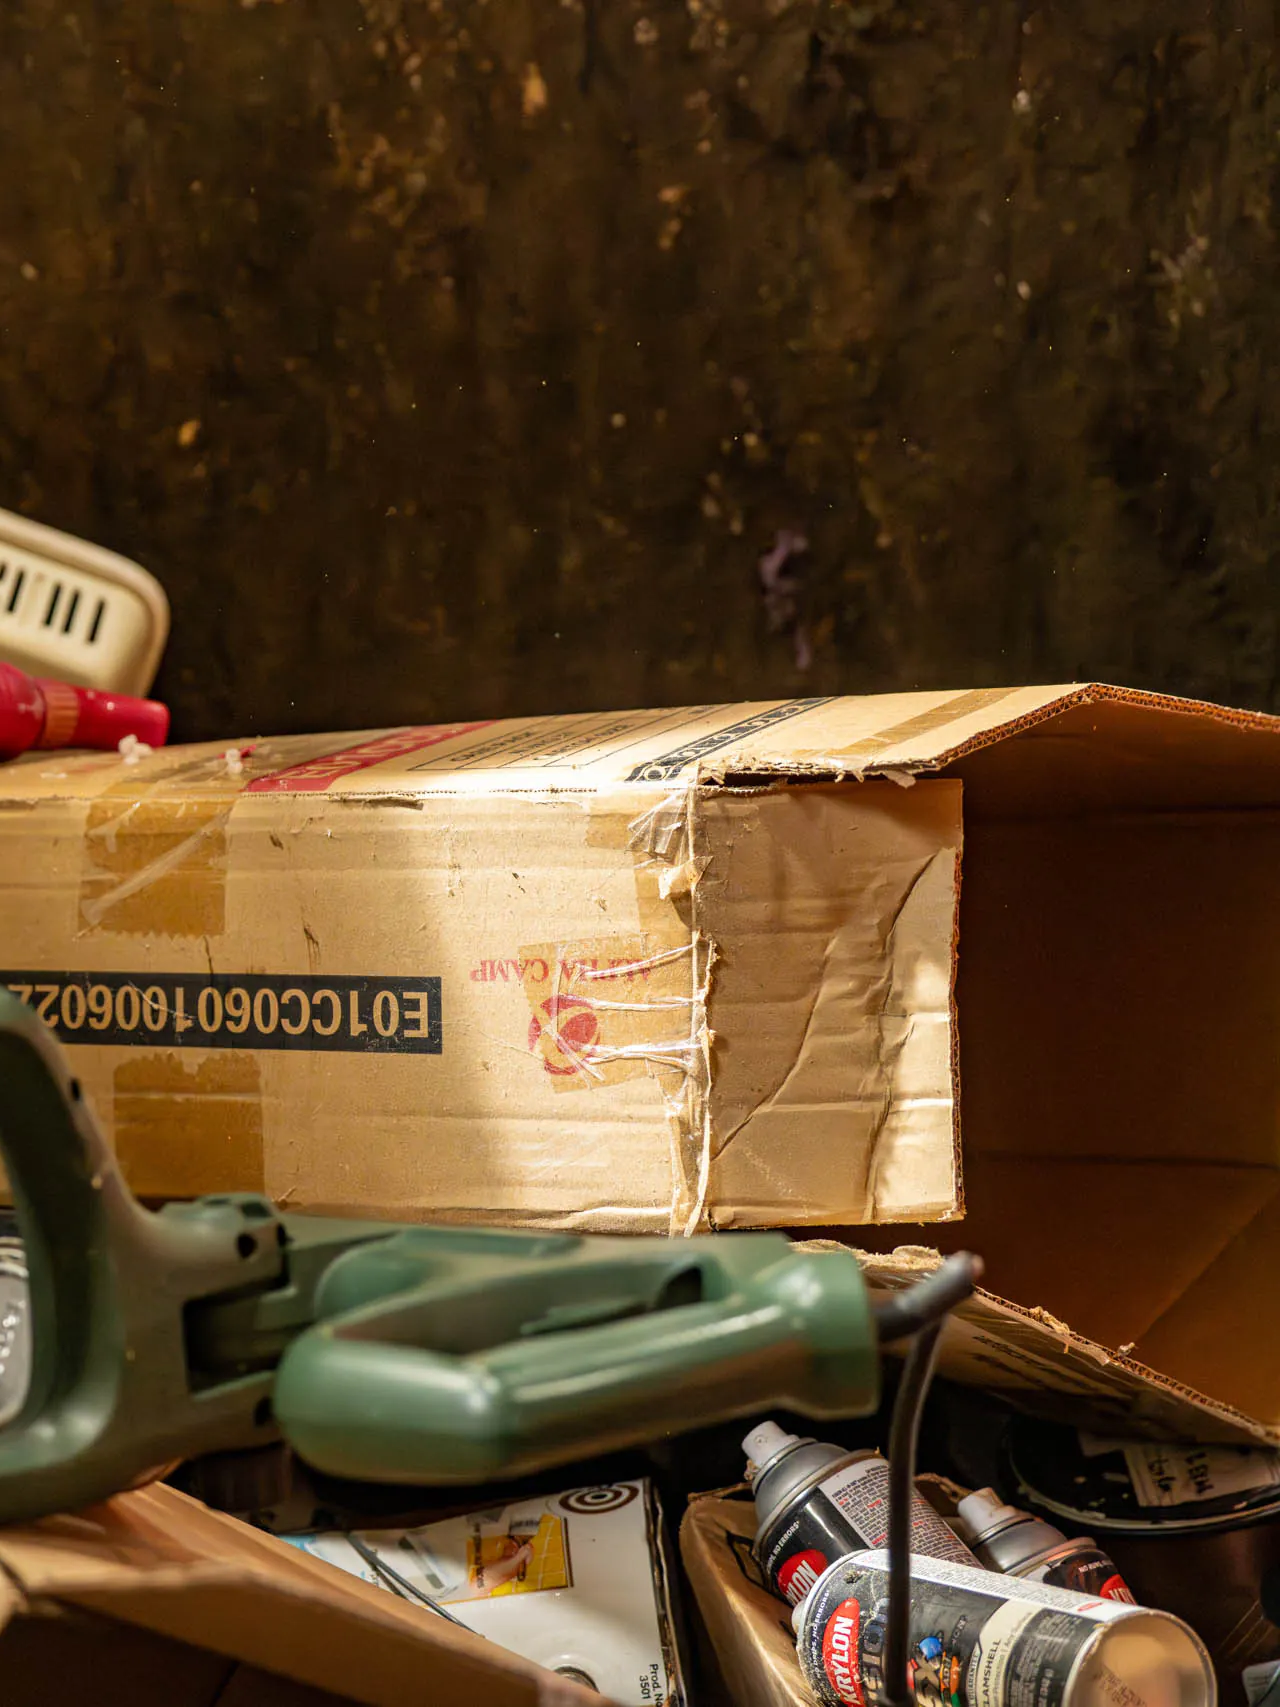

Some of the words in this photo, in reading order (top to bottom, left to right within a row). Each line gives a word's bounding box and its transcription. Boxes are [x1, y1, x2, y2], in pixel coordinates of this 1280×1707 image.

[470, 958, 550, 983] CAMP
[832, 1616, 860, 1705] KRYLON
[981, 1639, 1001, 1707] LAMSHELL
[639, 1675, 652, 1700] 3501
[649, 1663, 662, 1691] Prod.
